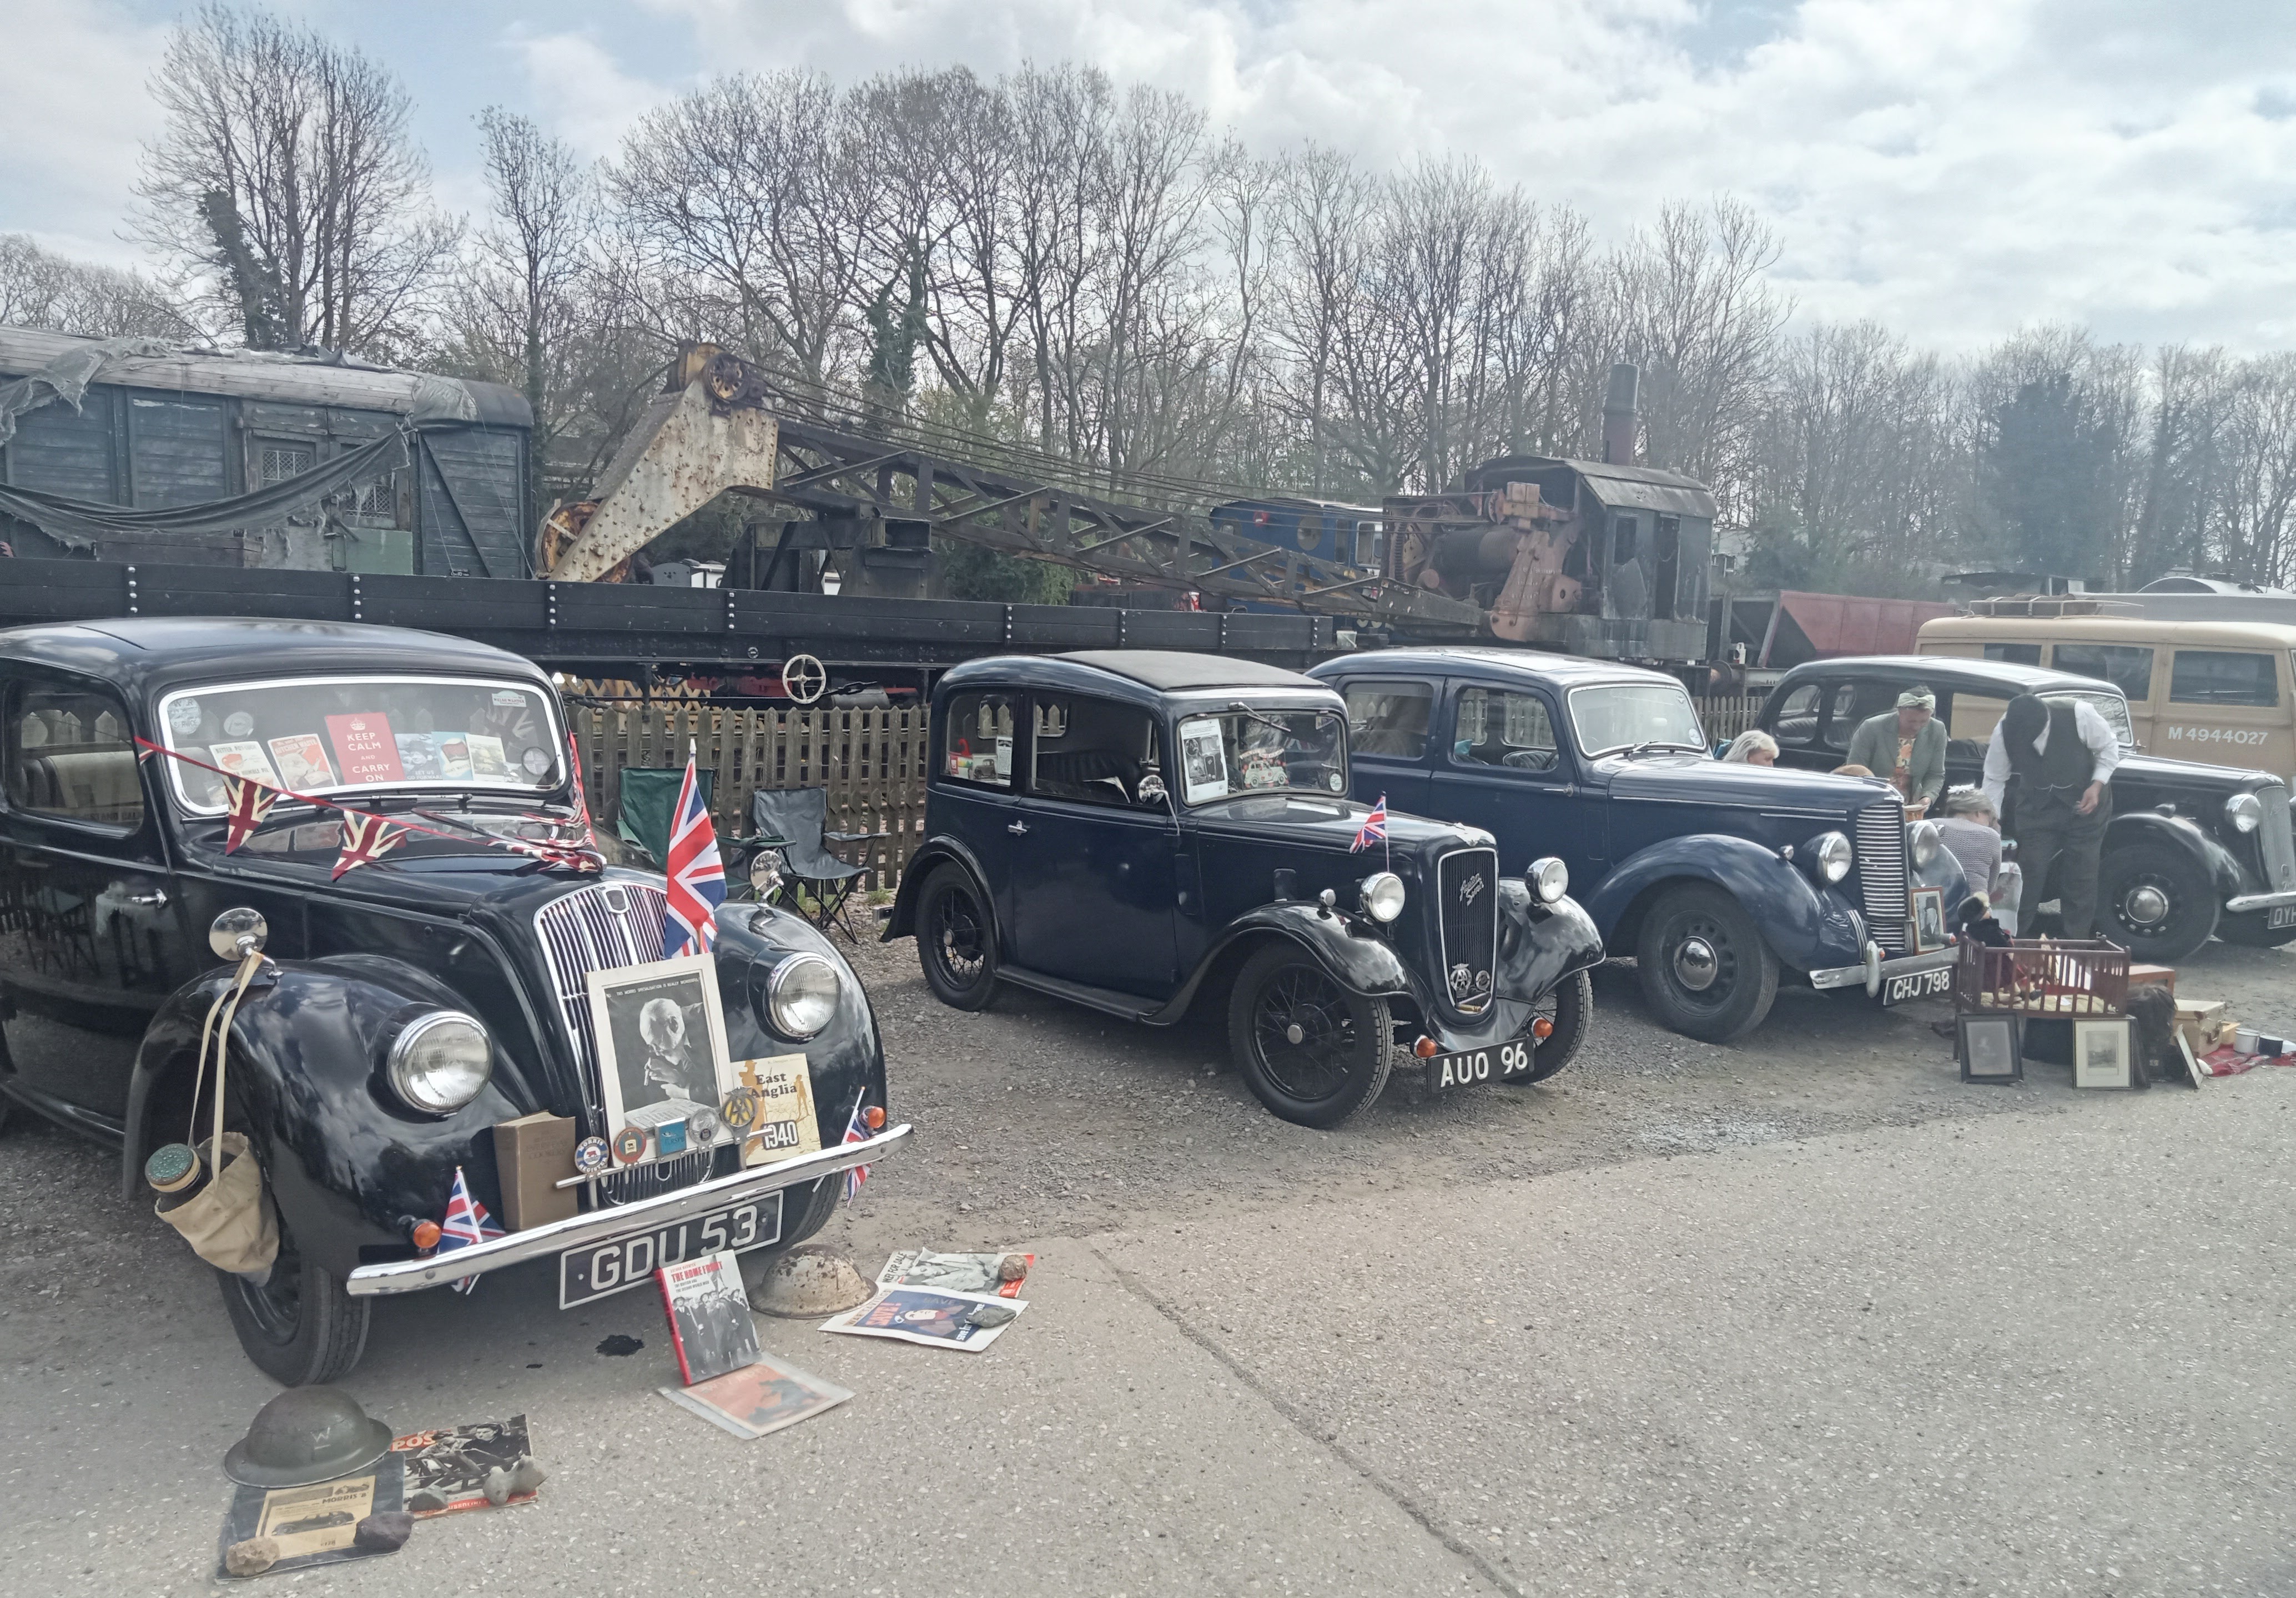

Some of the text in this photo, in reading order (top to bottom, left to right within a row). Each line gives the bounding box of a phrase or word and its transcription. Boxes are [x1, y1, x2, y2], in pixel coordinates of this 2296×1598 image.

[346, 732, 375, 741] KEEP
[2168, 727, 2268, 745] M 4944027
[348, 742, 381, 750] CALM
[352, 764, 390, 773] CARRY
[1893, 971, 1950, 1000] CHJ 798
[1441, 1042, 1528, 1087] AUO 96
[756, 1073, 787, 1085] East
[751, 1085, 797, 1098] Anglia
[763, 1122, 798, 1148] 1940
[580, 1140, 603, 1151] MORRIS
[578, 1157, 607, 1172] REGISTER
[591, 1205, 757, 1291] GDU 53
[893, 1251, 907, 1264] SALE
[671, 1261, 723, 1283] THE HOME FRONT
[843, 1289, 892, 1325] WAR SAVINGS
[866, 1302, 902, 1325] SAVE!
[310, 1426, 331, 1443] W
[323, 1494, 358, 1504] MORRIS
